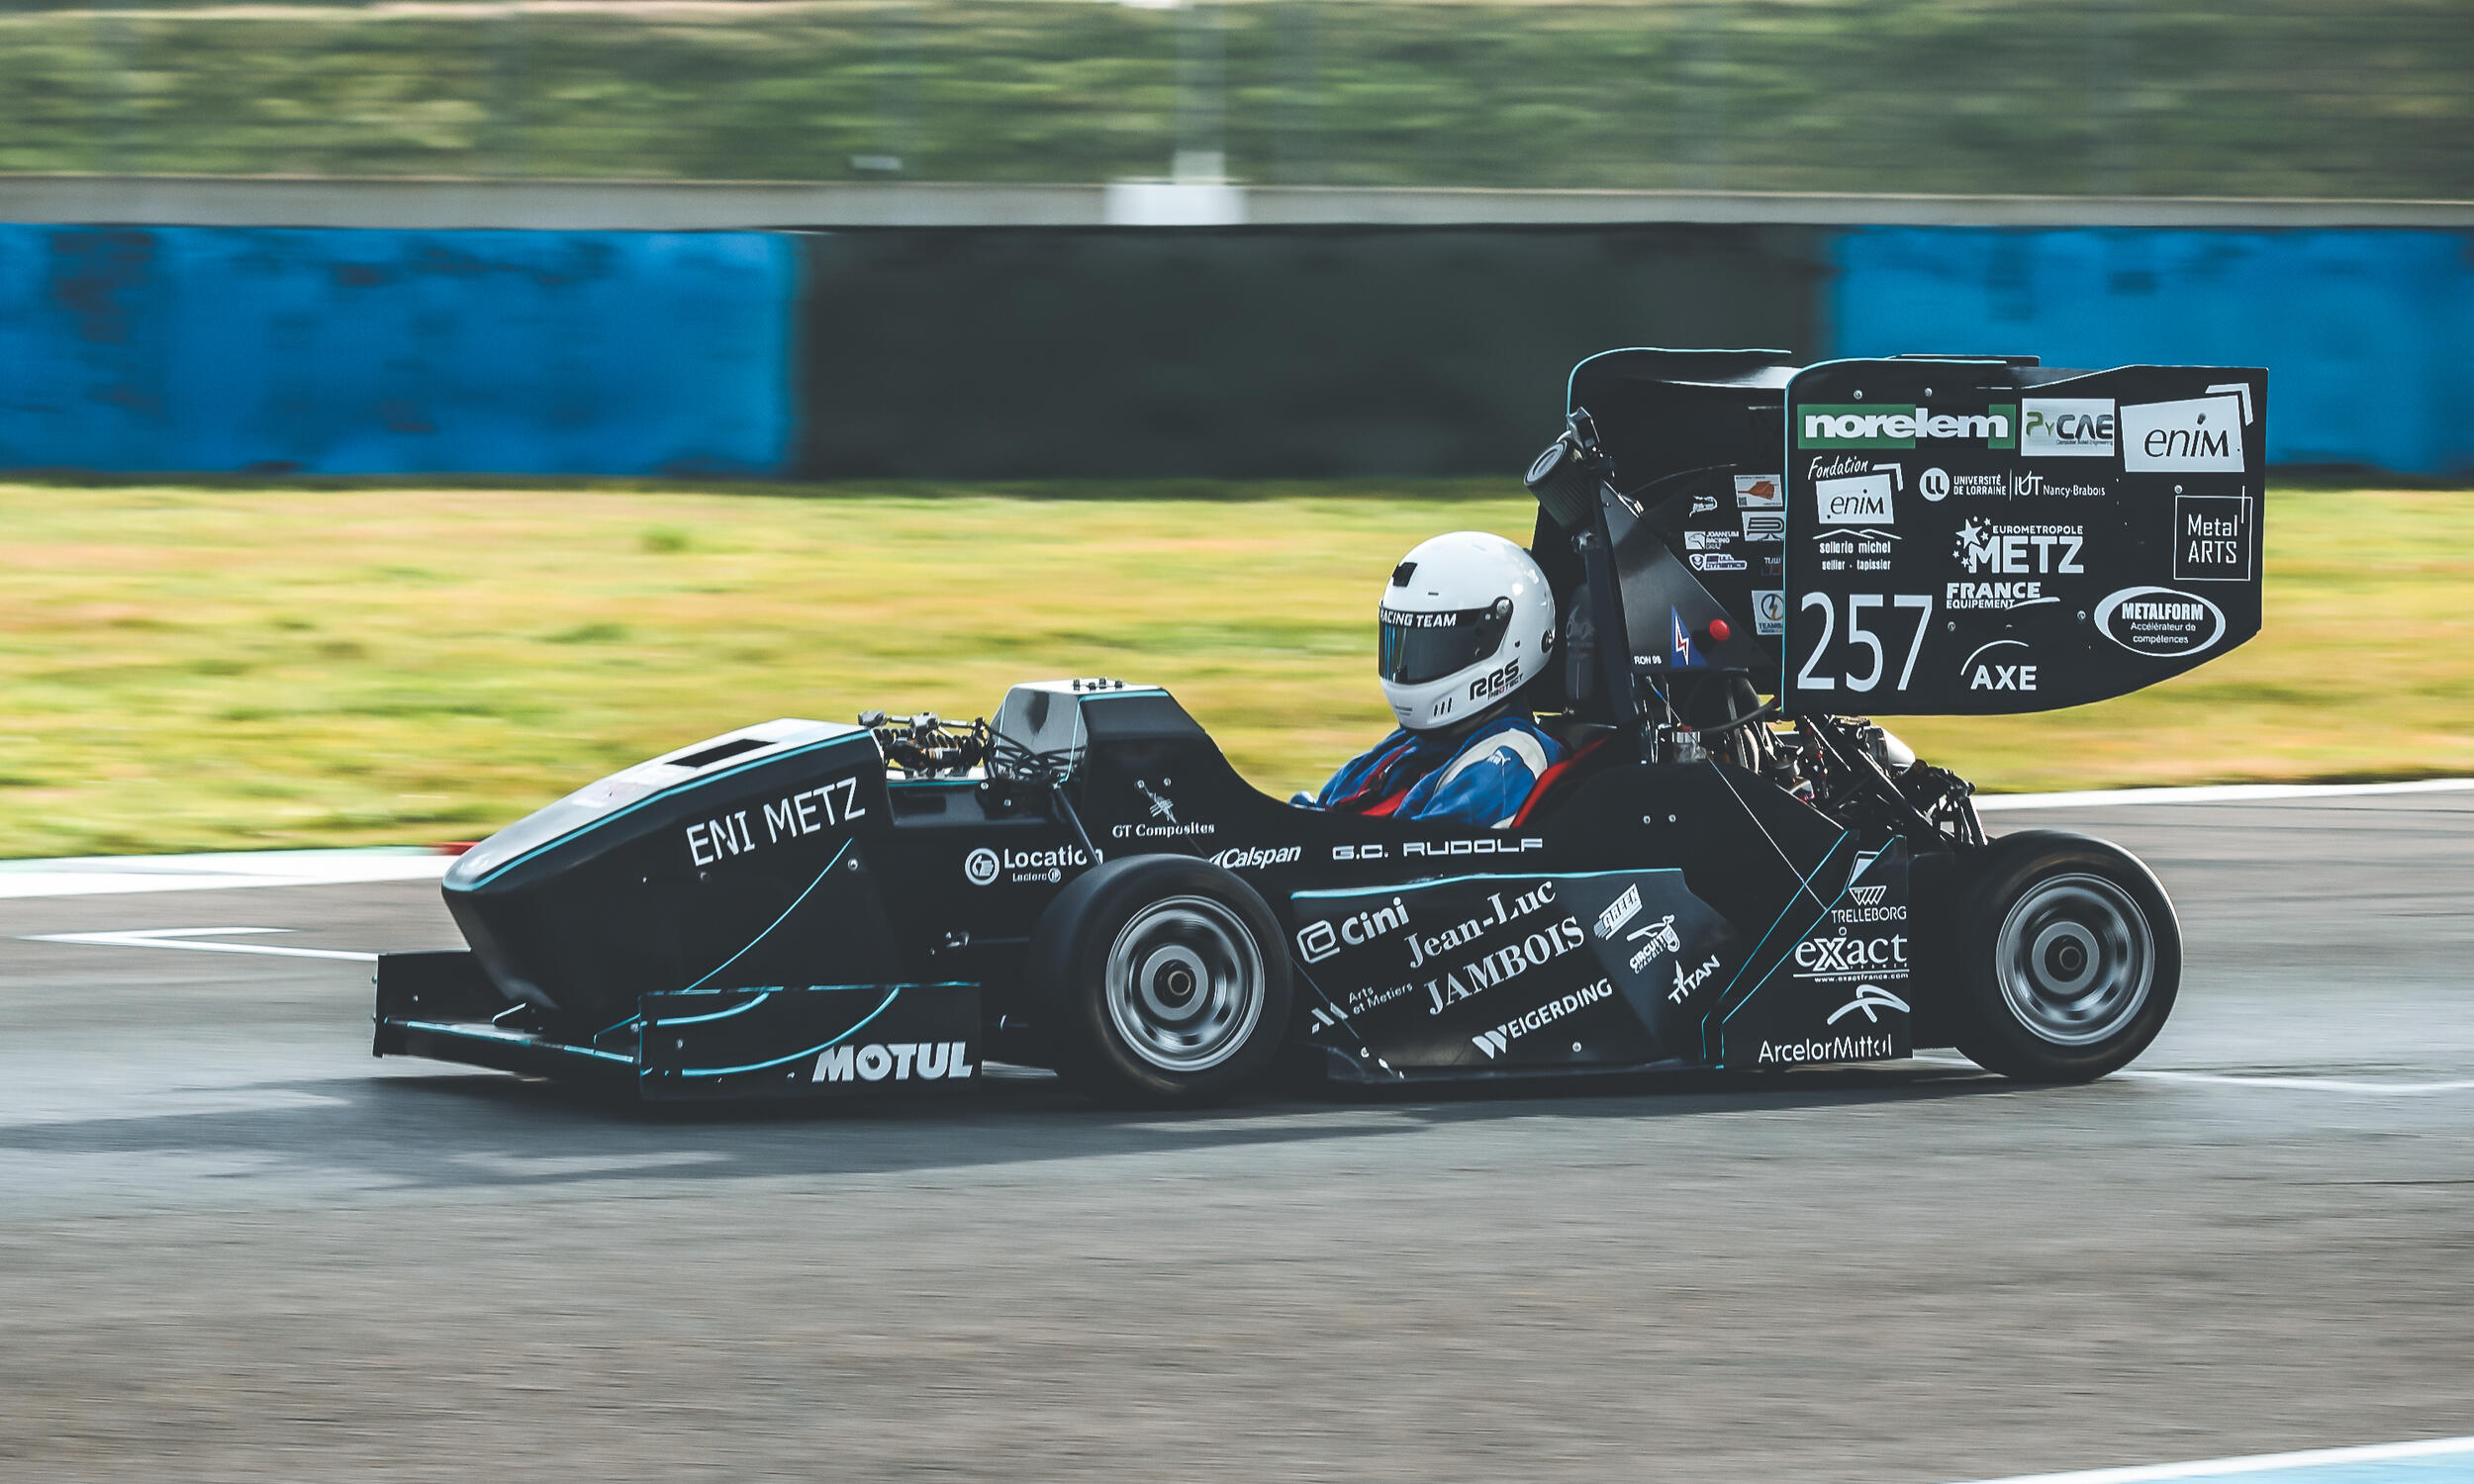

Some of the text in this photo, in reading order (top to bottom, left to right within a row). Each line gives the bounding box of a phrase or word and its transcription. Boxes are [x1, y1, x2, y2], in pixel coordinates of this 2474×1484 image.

[1805, 408, 2008, 438] norelem
[1807, 455, 1869, 480] Fondation
[1953, 473, 2001, 486] UNIVERSITÉ
[1953, 485, 2007, 496] DE LORRAINE
[1992, 525, 2083, 535] EUROMETROPOLE
[2187, 513, 2238, 537] Metal
[1857, 540, 1891, 554] michel
[1967, 535, 2084, 574] METZ
[2187, 539, 2237, 564] ARTS
[1946, 582, 2042, 600] FRANCE
[1946, 599, 2015, 609] EQUIPEMENT
[2122, 603, 2204, 621] METALFORM
[1416, 612, 1458, 628] TEAM
[2184, 622, 2197, 632] de
[1797, 591, 1933, 693] 257
[1970, 664, 2038, 691] AXE
[686, 776, 866, 867] ENI METZ
[1111, 824, 1133, 838] GT
[1222, 845, 1302, 870] Calspan
[1403, 838, 1543, 858] RUDOLF
[1404, 881, 1557, 969] Jean-Luc
[1831, 905, 1907, 924] TRELLEBORG
[1629, 934, 1665, 970] CIRCUIT
[1423, 915, 1584, 1016] JAMBOIS
[1348, 985, 1375, 1005] Arts
[1472, 977, 1613, 1060] WEIGERDING
[811, 1041, 974, 1083] MOTUL
